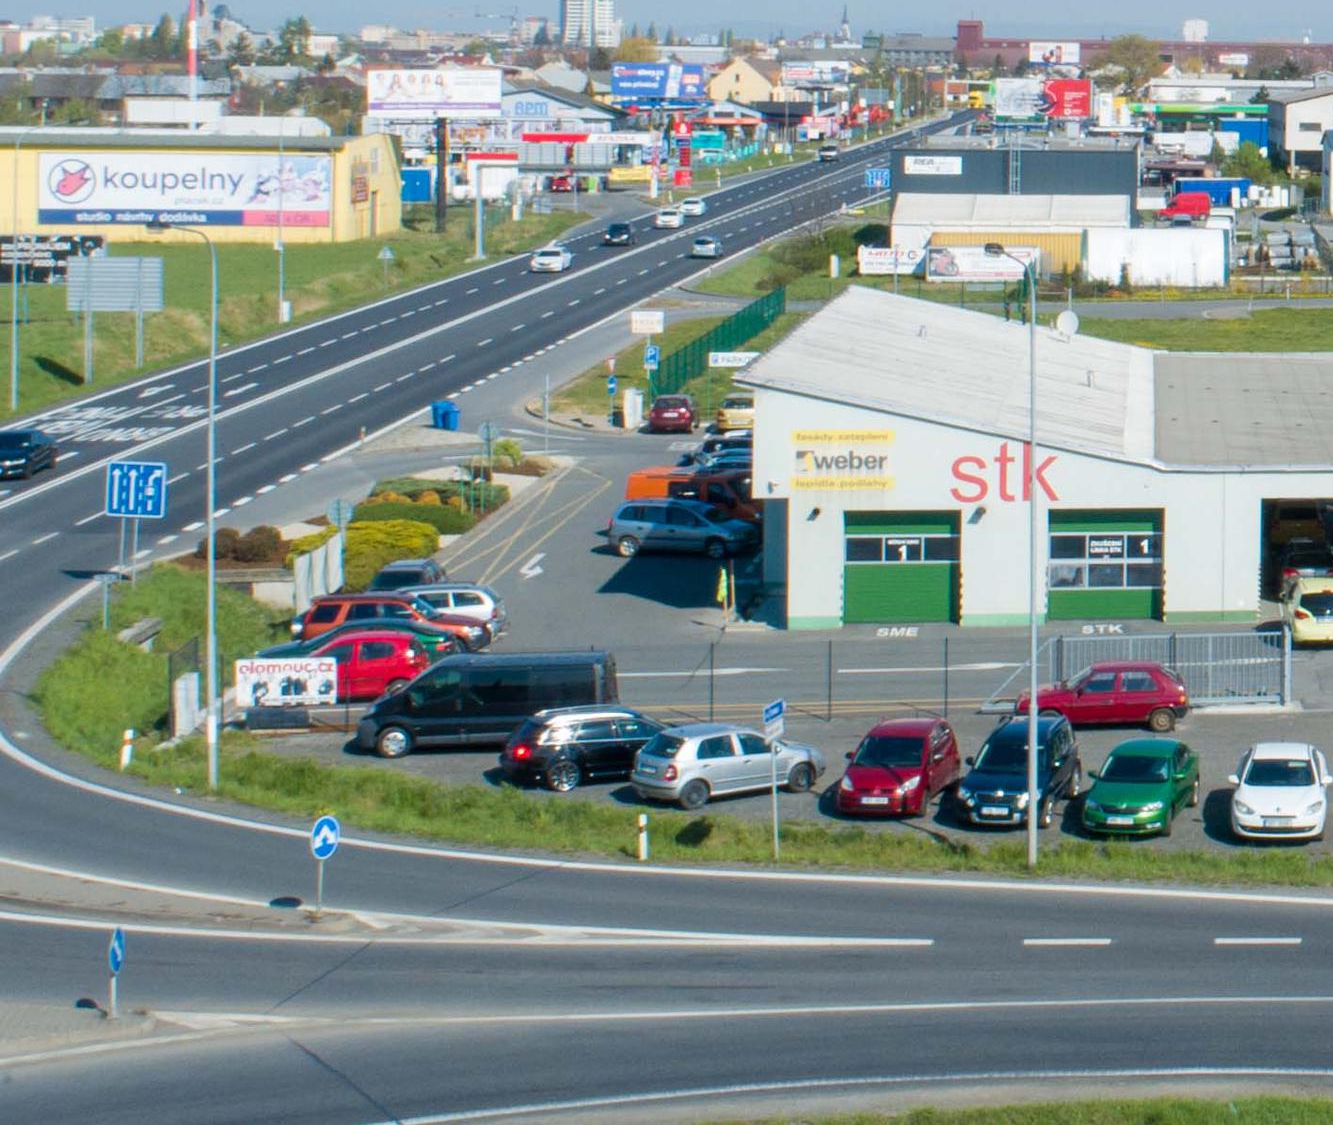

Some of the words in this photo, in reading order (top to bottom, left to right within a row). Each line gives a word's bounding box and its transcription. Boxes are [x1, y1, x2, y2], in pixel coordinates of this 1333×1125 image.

[103, 165, 244, 195] koupelny
[76, 211, 112, 222] studio
[814, 450, 888, 470] weber
[949, 440, 1060, 503] stk
[898, 545, 907, 561] 1
[1140, 538, 1149, 554] 1
[876, 626, 920, 637] SME
[1081, 624, 1124, 635] STK
[239, 660, 334, 675] olomouc.cz
